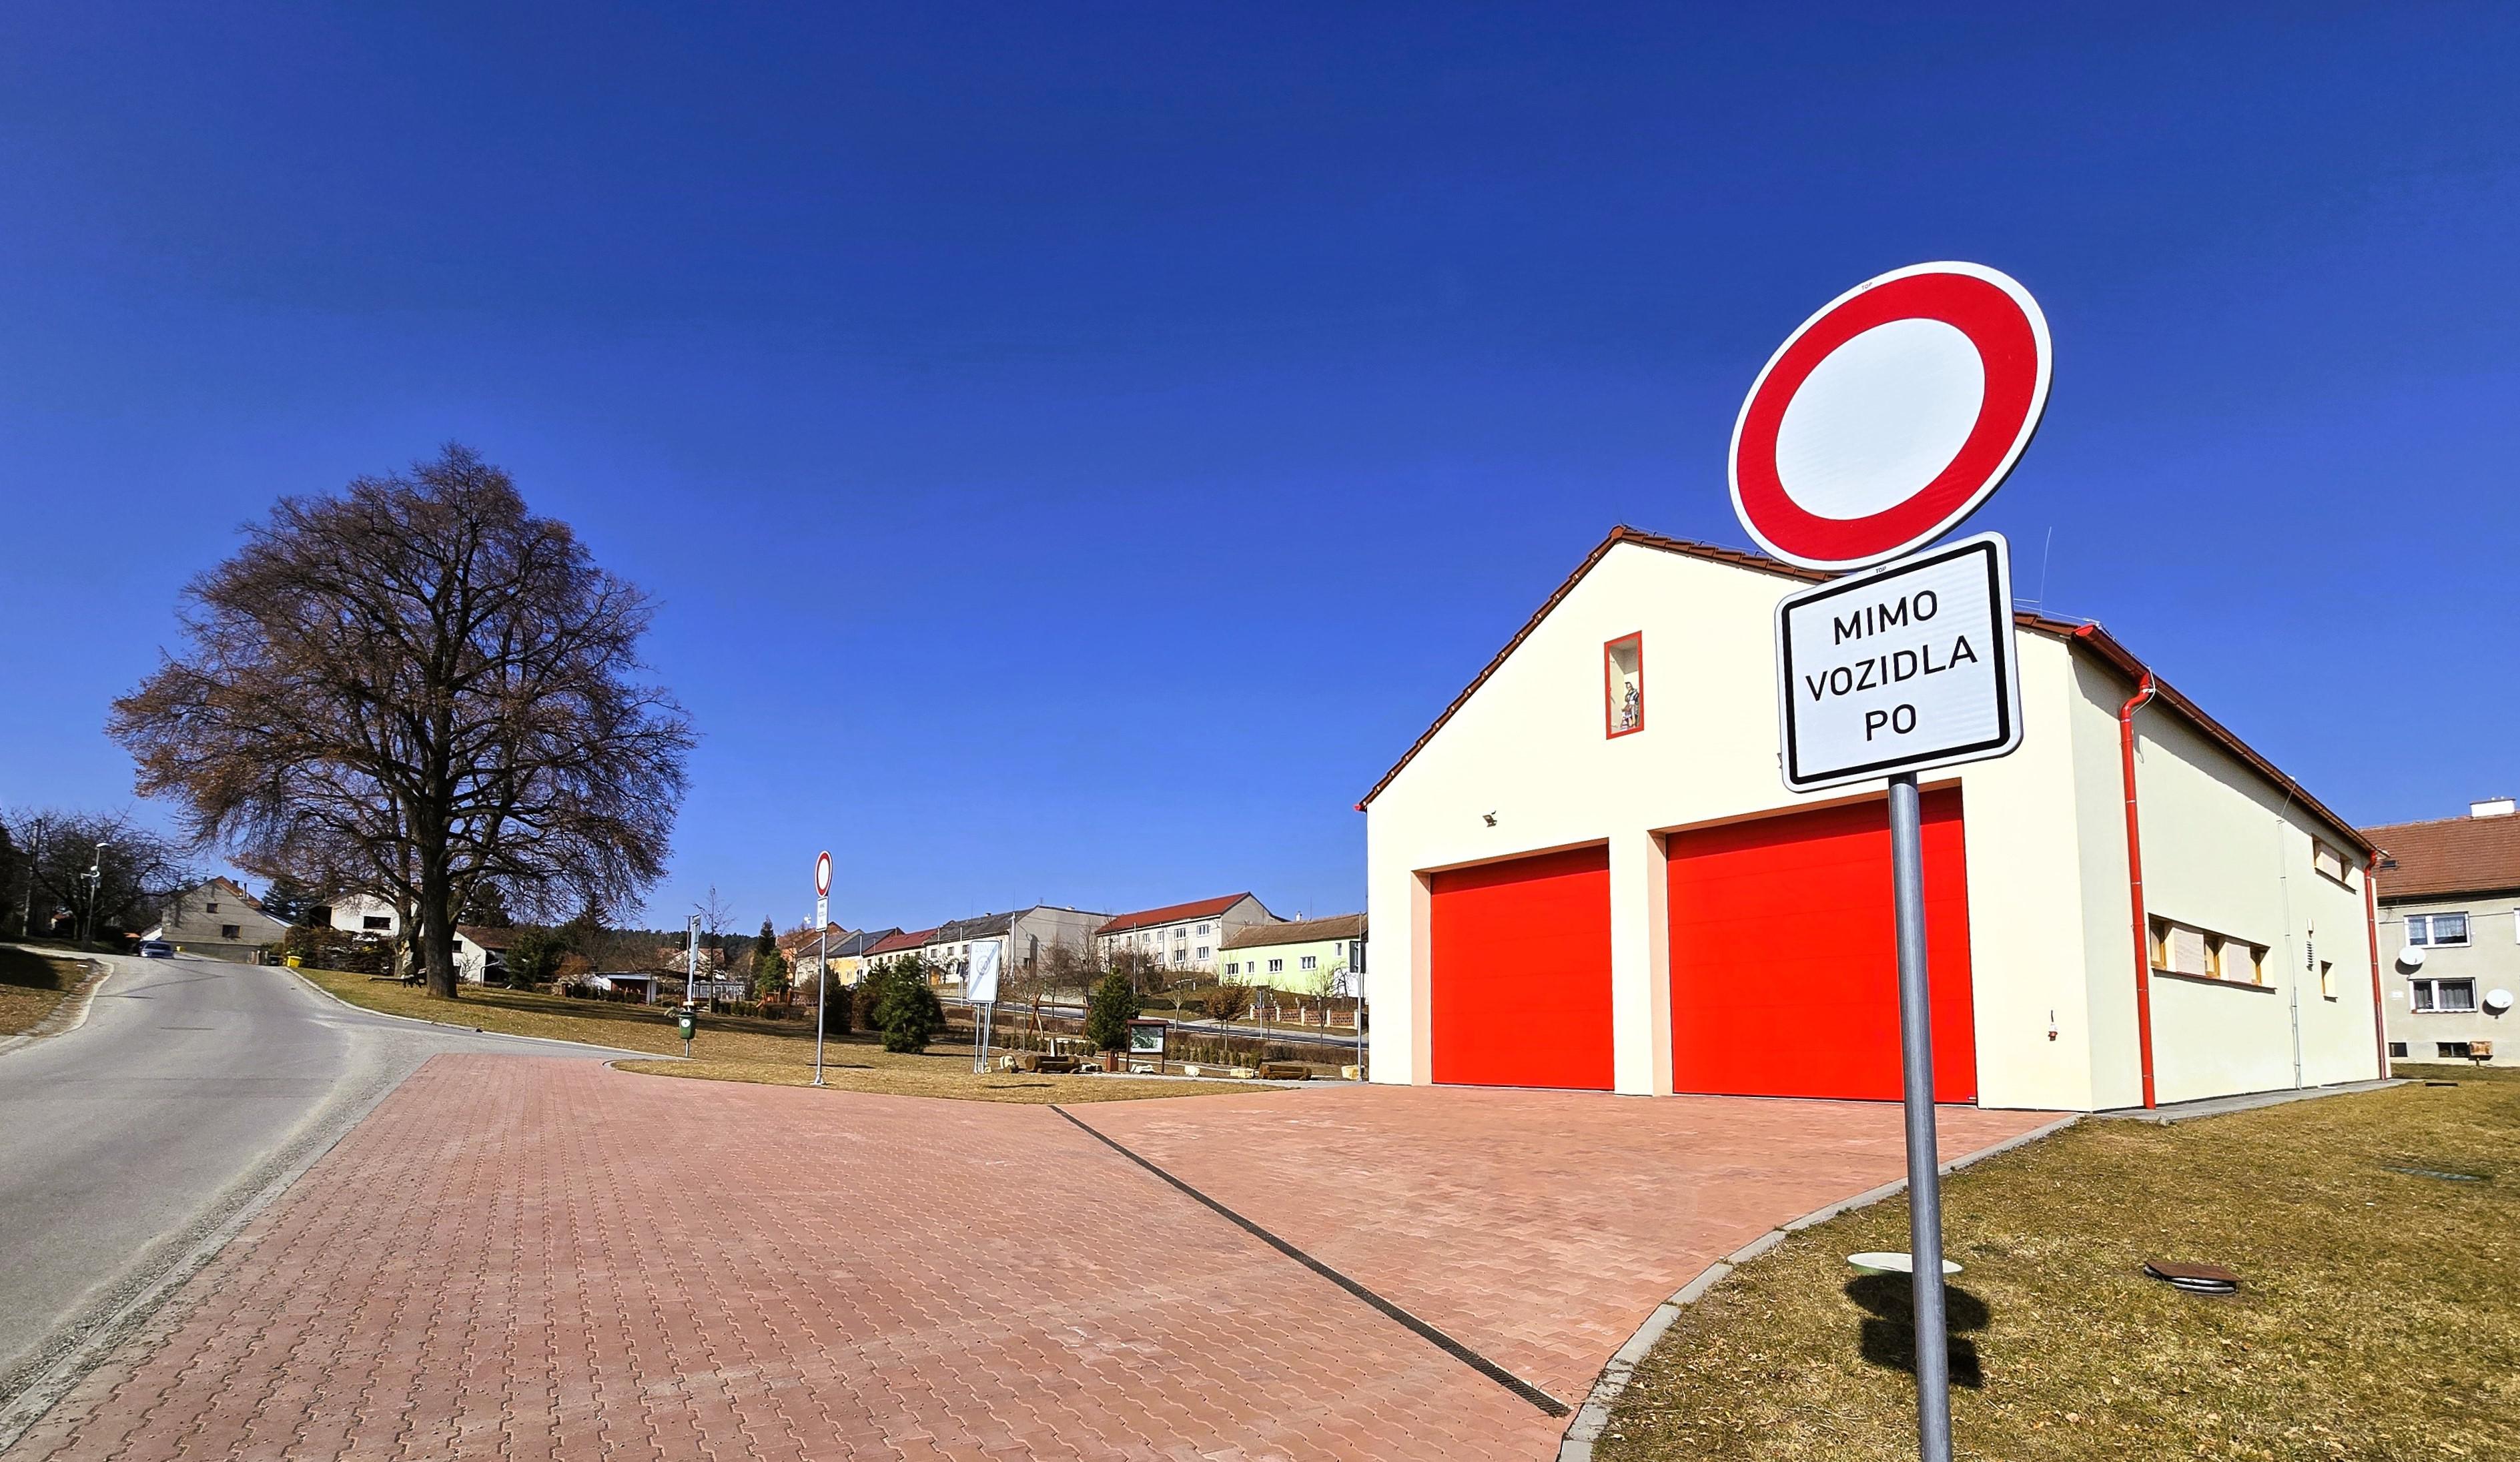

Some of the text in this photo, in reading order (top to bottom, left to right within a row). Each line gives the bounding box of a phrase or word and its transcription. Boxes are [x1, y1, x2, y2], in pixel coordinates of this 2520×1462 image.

[1861, 282, 1873, 290] TOP
[1875, 565, 1887, 574] TOP
[1833, 590, 1938, 645] MIMO
[1805, 635, 1978, 701] VOZIDLA
[1865, 703, 1916, 741] PO
